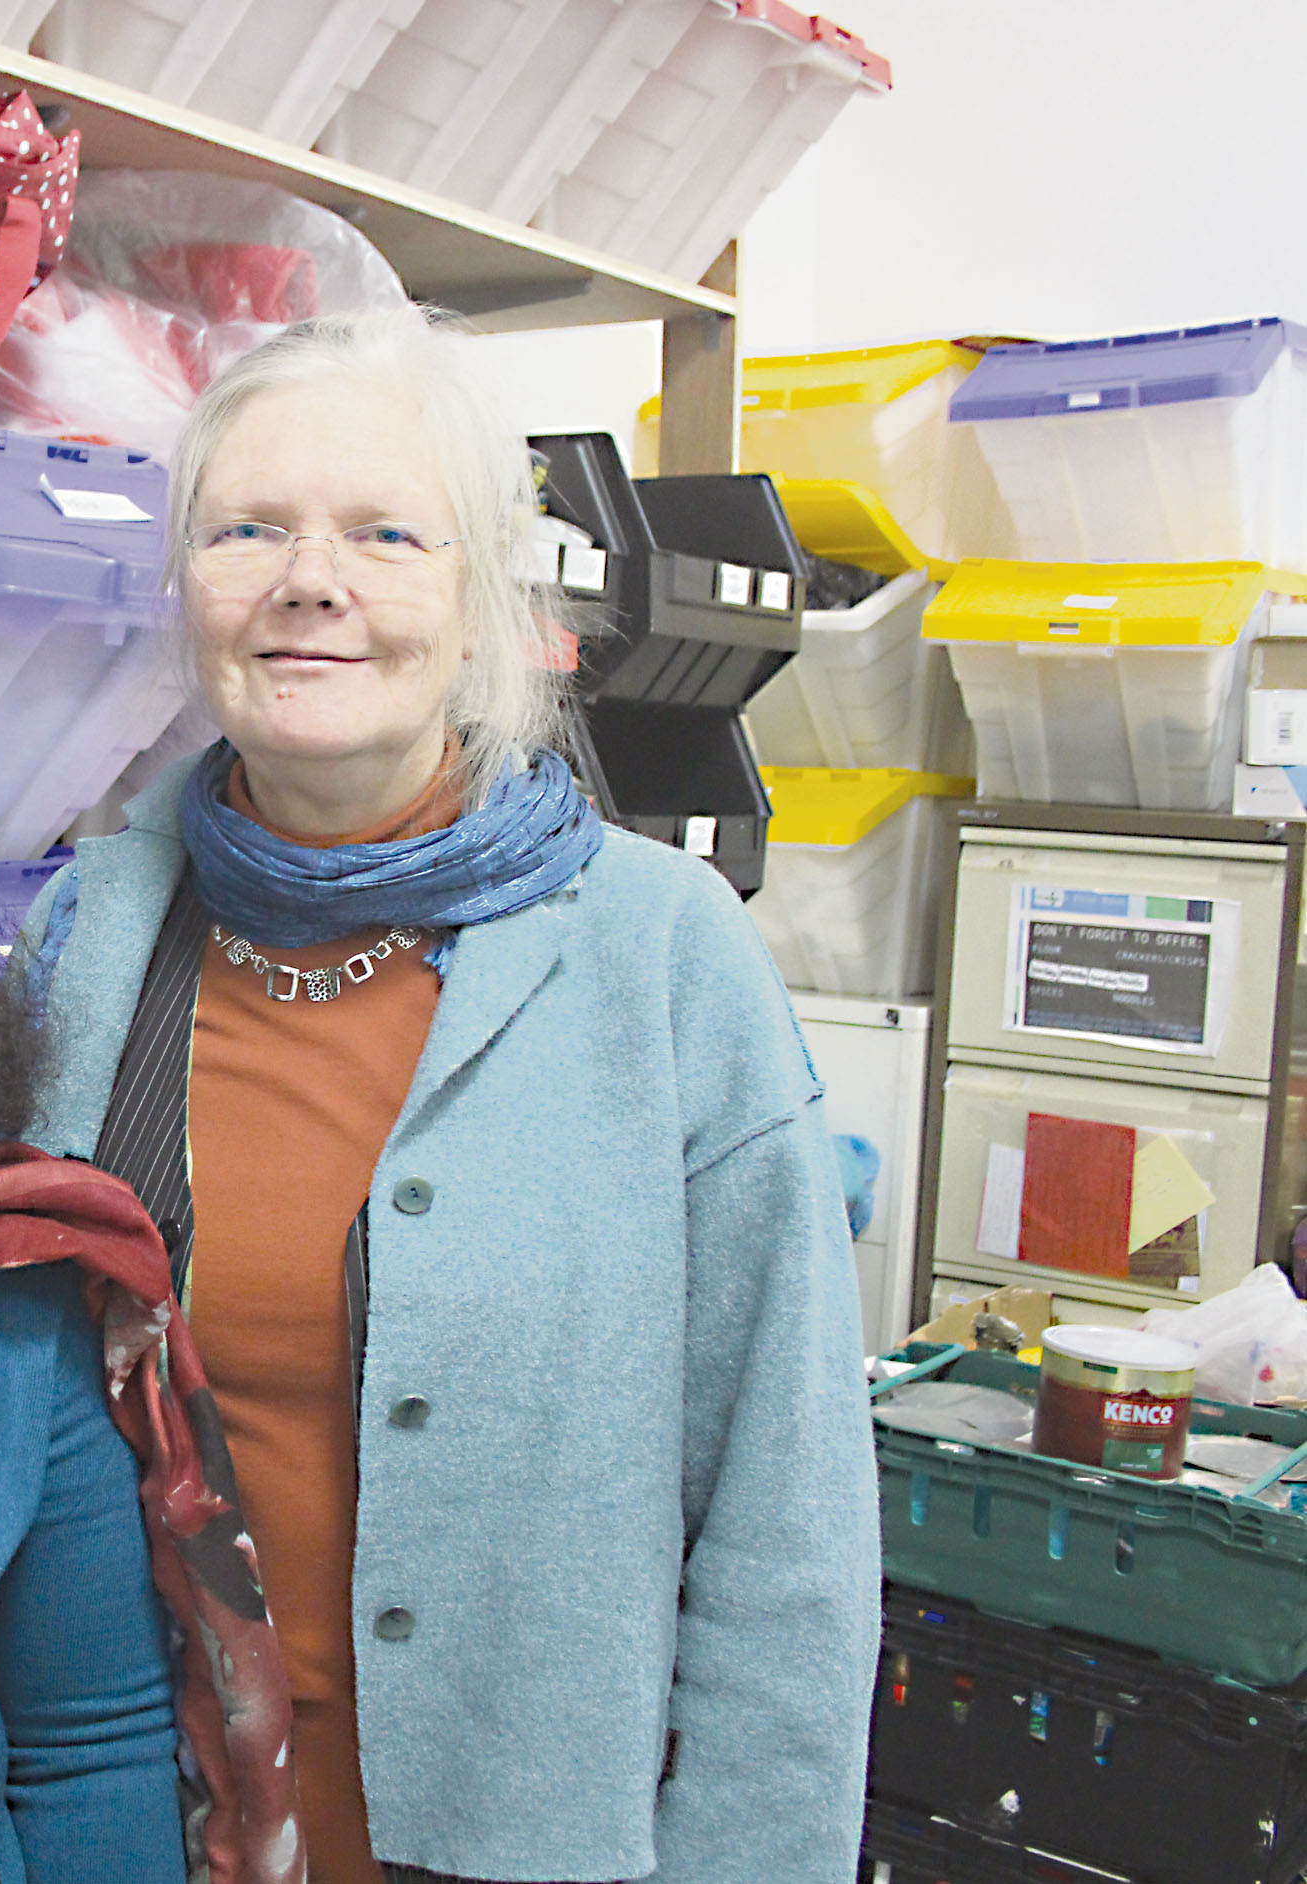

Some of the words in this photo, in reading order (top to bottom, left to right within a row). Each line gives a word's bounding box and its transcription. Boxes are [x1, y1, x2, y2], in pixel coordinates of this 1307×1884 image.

[1033, 923, 1074, 937] DON'T
[1079, 926, 1126, 942] FORGET
[1133, 931, 1150, 944] TO
[1155, 933, 1205, 949] OFFER:
[1115, 949, 1206, 968] CRACKERS/CRISPS
[1104, 1401, 1173, 1424] KENCO
